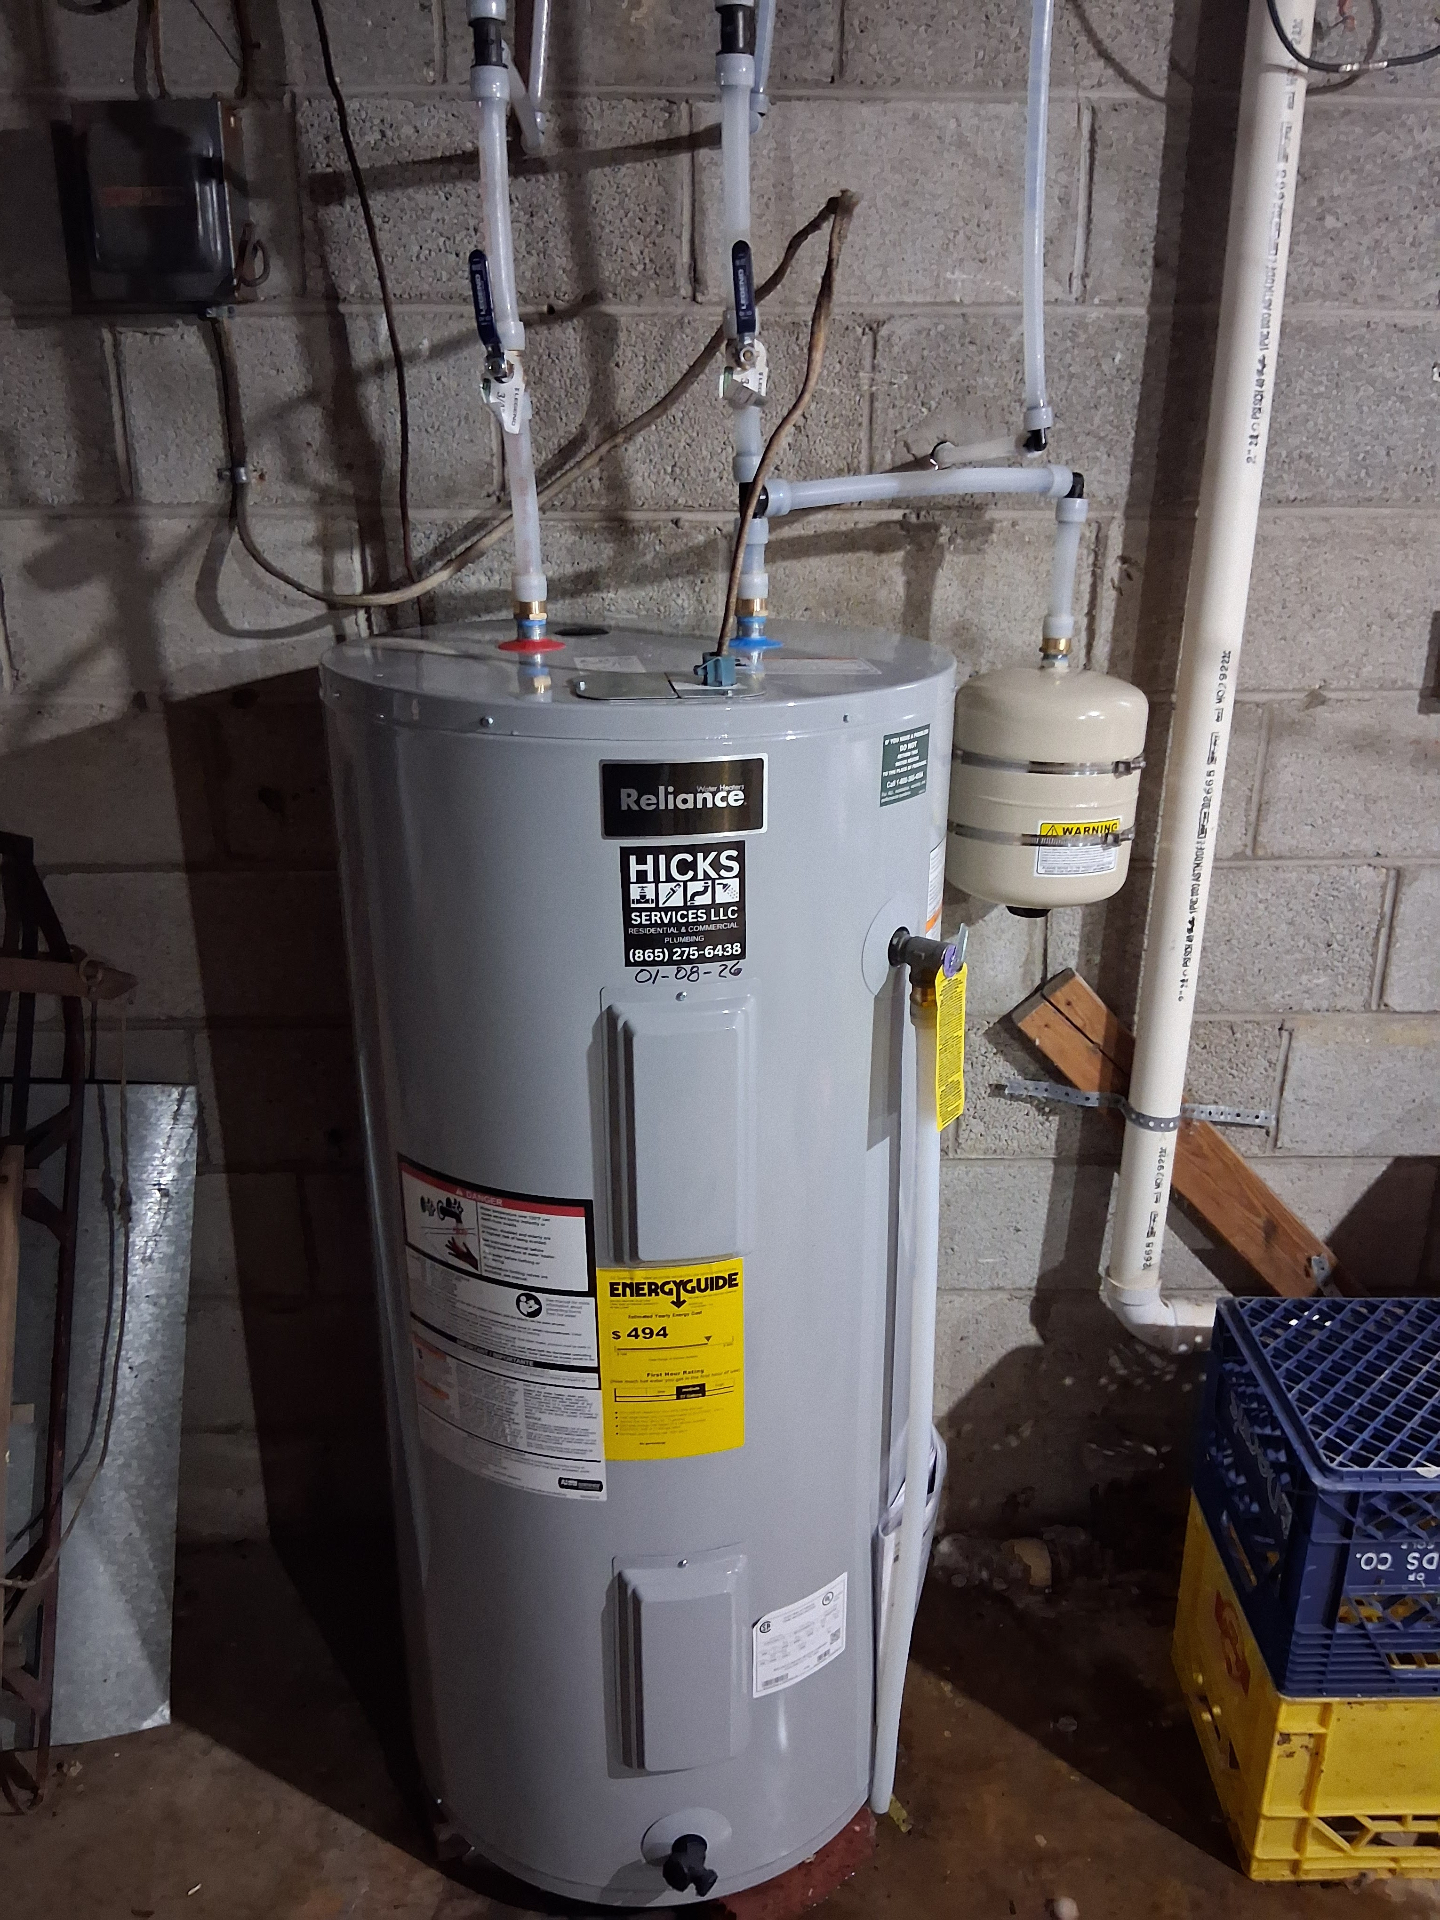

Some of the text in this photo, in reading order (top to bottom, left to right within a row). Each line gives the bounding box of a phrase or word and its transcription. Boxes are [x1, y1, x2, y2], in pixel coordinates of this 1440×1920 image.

[738, 268, 746, 310] LEGEND
[697, 783, 744, 792] Water Heaters
[620, 786, 745, 810] Reliance
[629, 850, 740, 882] HICKS
[631, 907, 738, 924] SERVICES LLC
[629, 926, 679, 934] RESIDENTIAL
[688, 922, 739, 932] COMMERCIAL
[664, 935, 704, 944] PLUMBING
[629, 943, 742, 963] (865) 275-6438
[466, 1191, 502, 1206] DANGER
[609, 1272, 739, 1299] ENERGYGUIDE
[612, 1326, 668, 1340] $ 494
[1356, 1552, 1392, 1570] CO.
[1408, 1572, 1424, 1581] OF
